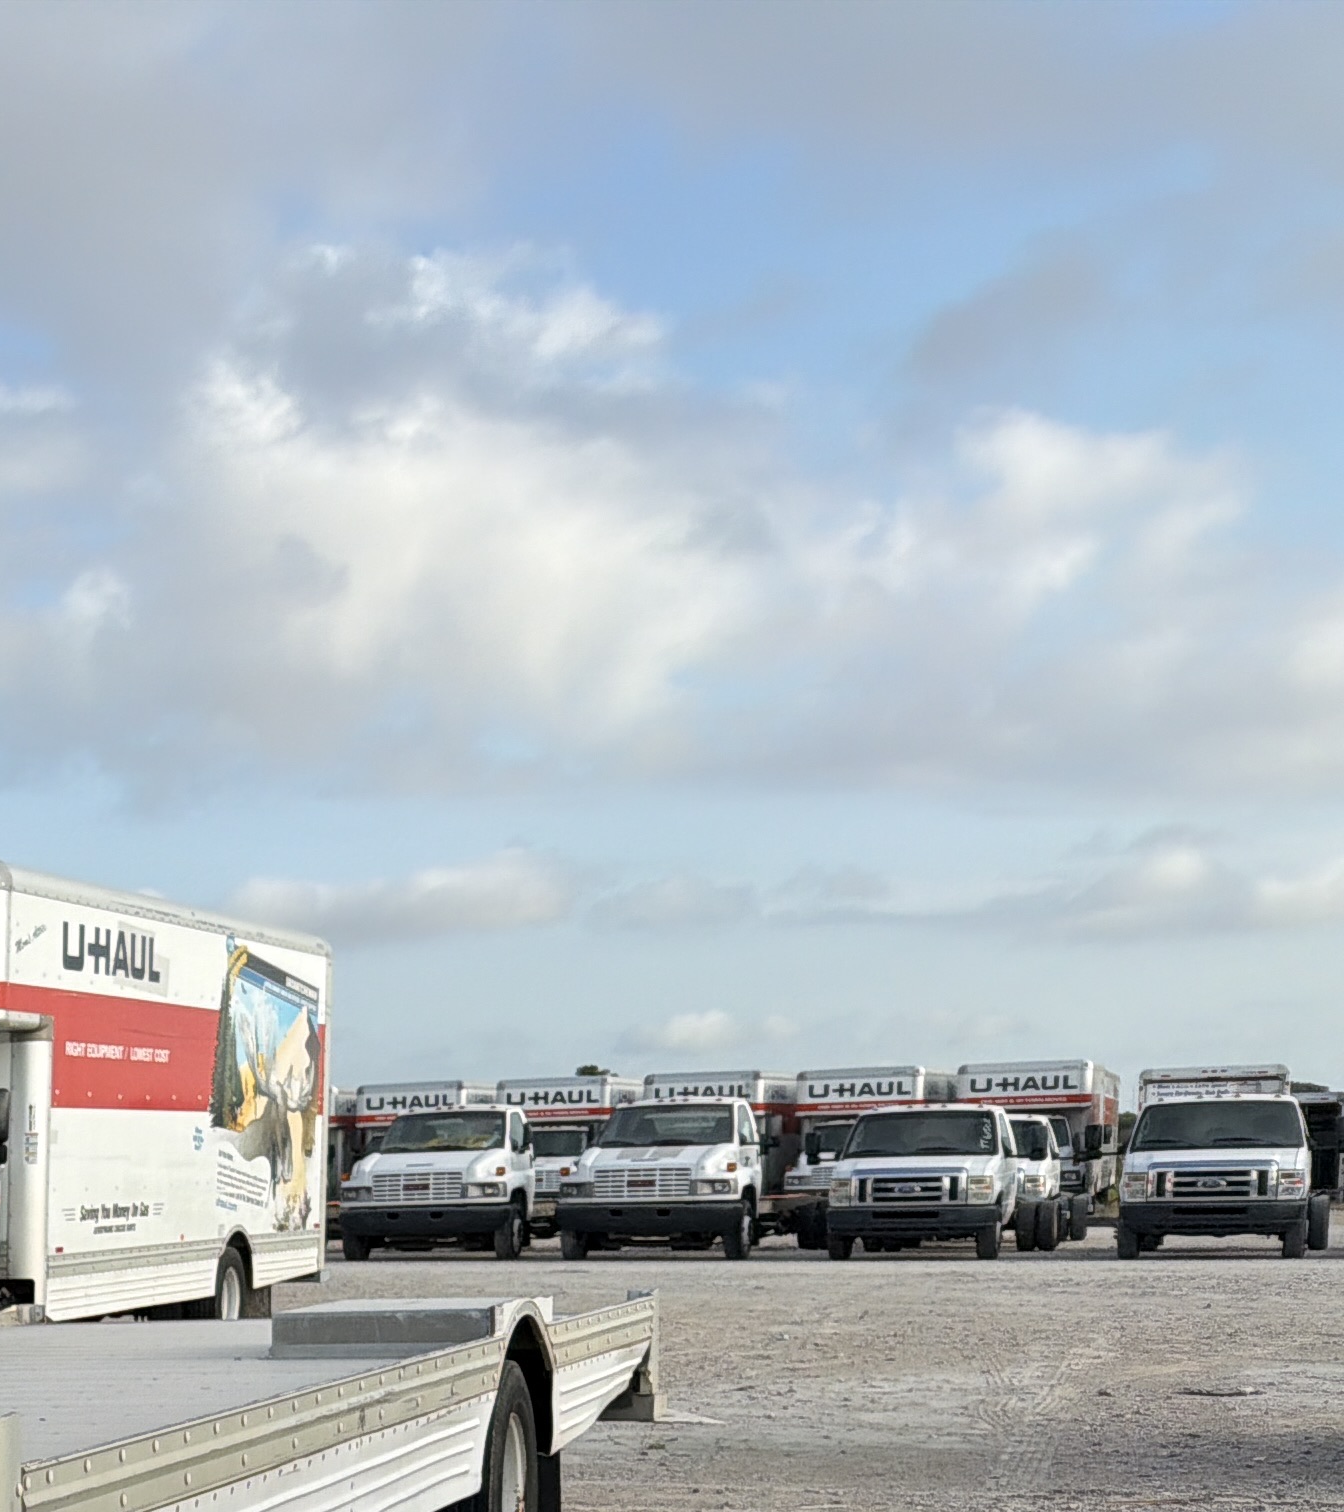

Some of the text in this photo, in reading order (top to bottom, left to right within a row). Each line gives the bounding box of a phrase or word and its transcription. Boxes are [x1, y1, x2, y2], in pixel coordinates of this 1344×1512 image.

[62, 921, 161, 984] U-HAUL
[808, 1080, 912, 1099] U-HAUL
[969, 1075, 1079, 1093] U-HAUL
[365, 1093, 454, 1111] U-HAUL
[506, 1089, 600, 1106] U-HAUL
